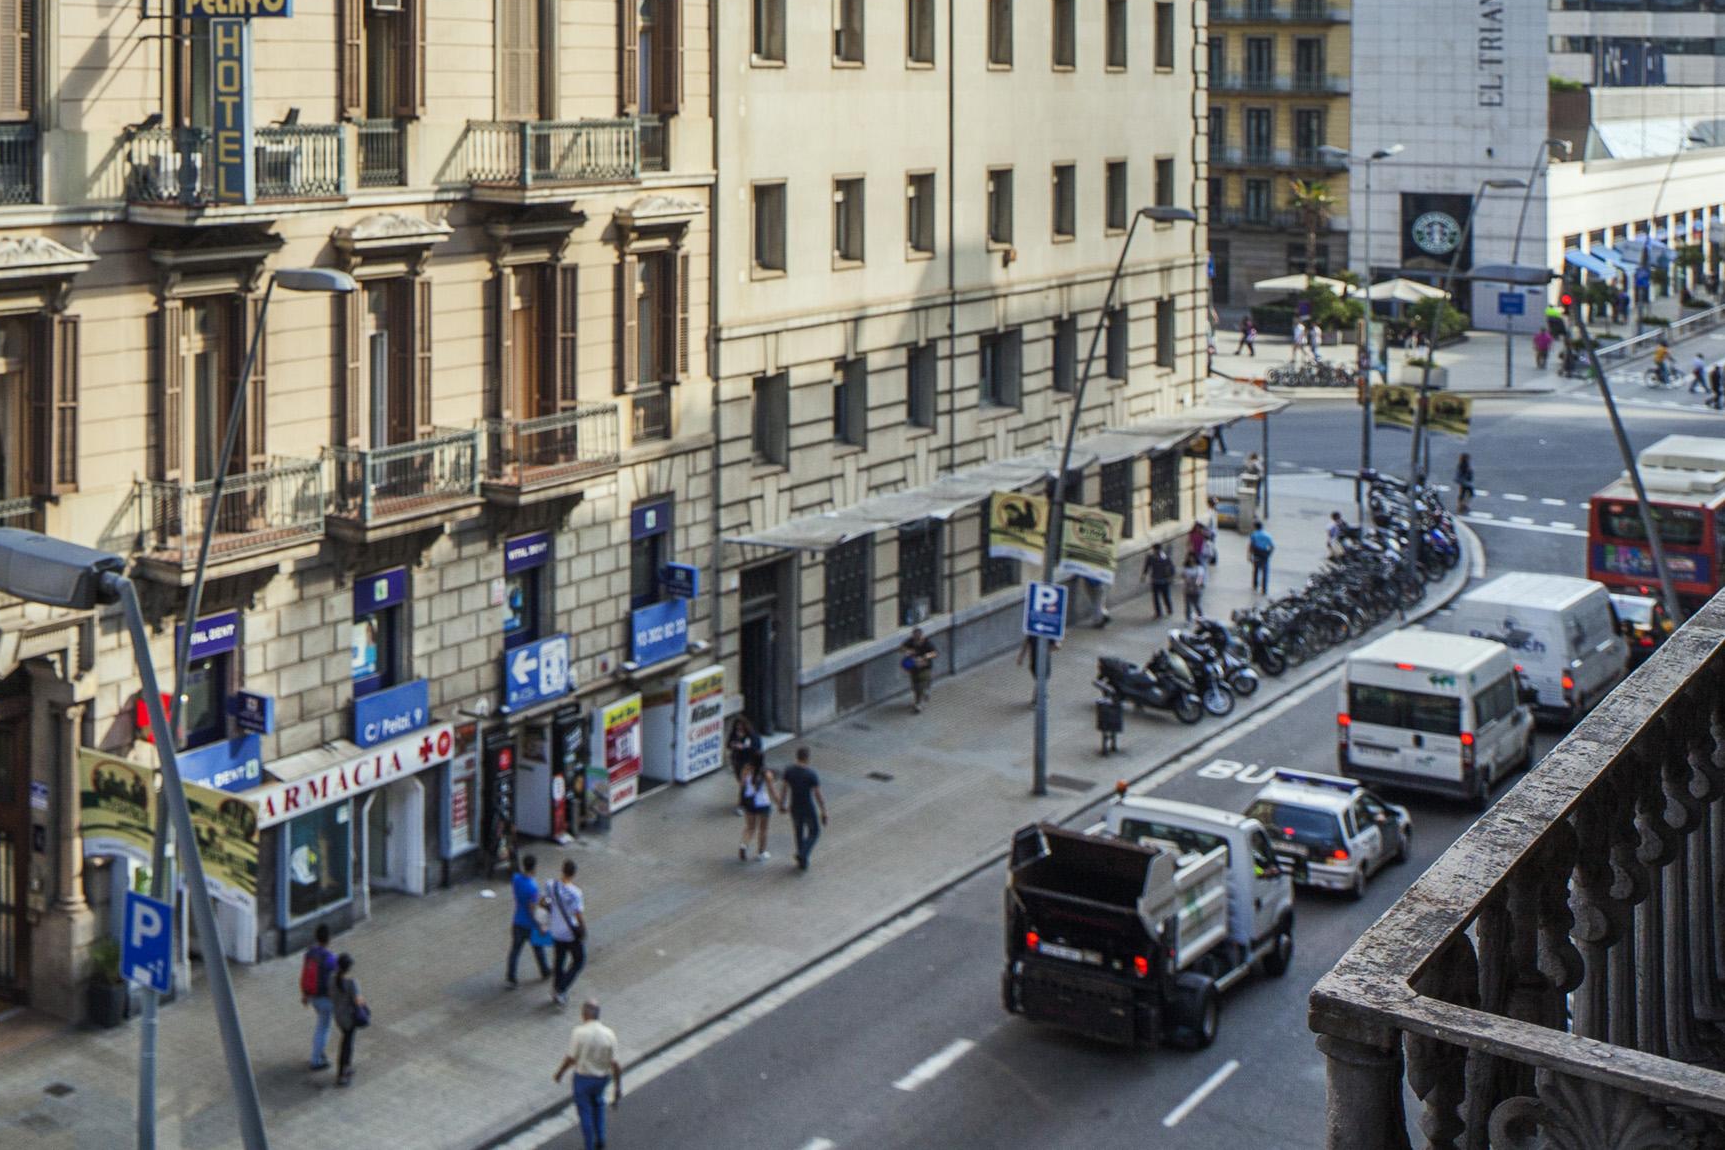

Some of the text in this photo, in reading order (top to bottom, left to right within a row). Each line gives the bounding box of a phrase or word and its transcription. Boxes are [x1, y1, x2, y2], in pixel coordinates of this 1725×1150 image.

[216, 24, 243, 199] HOTEL
[1034, 585, 1059, 612] P
[259, 751, 402, 820] ARMÀCIA
[1197, 759, 1275, 783] BU
[131, 901, 163, 948] P
